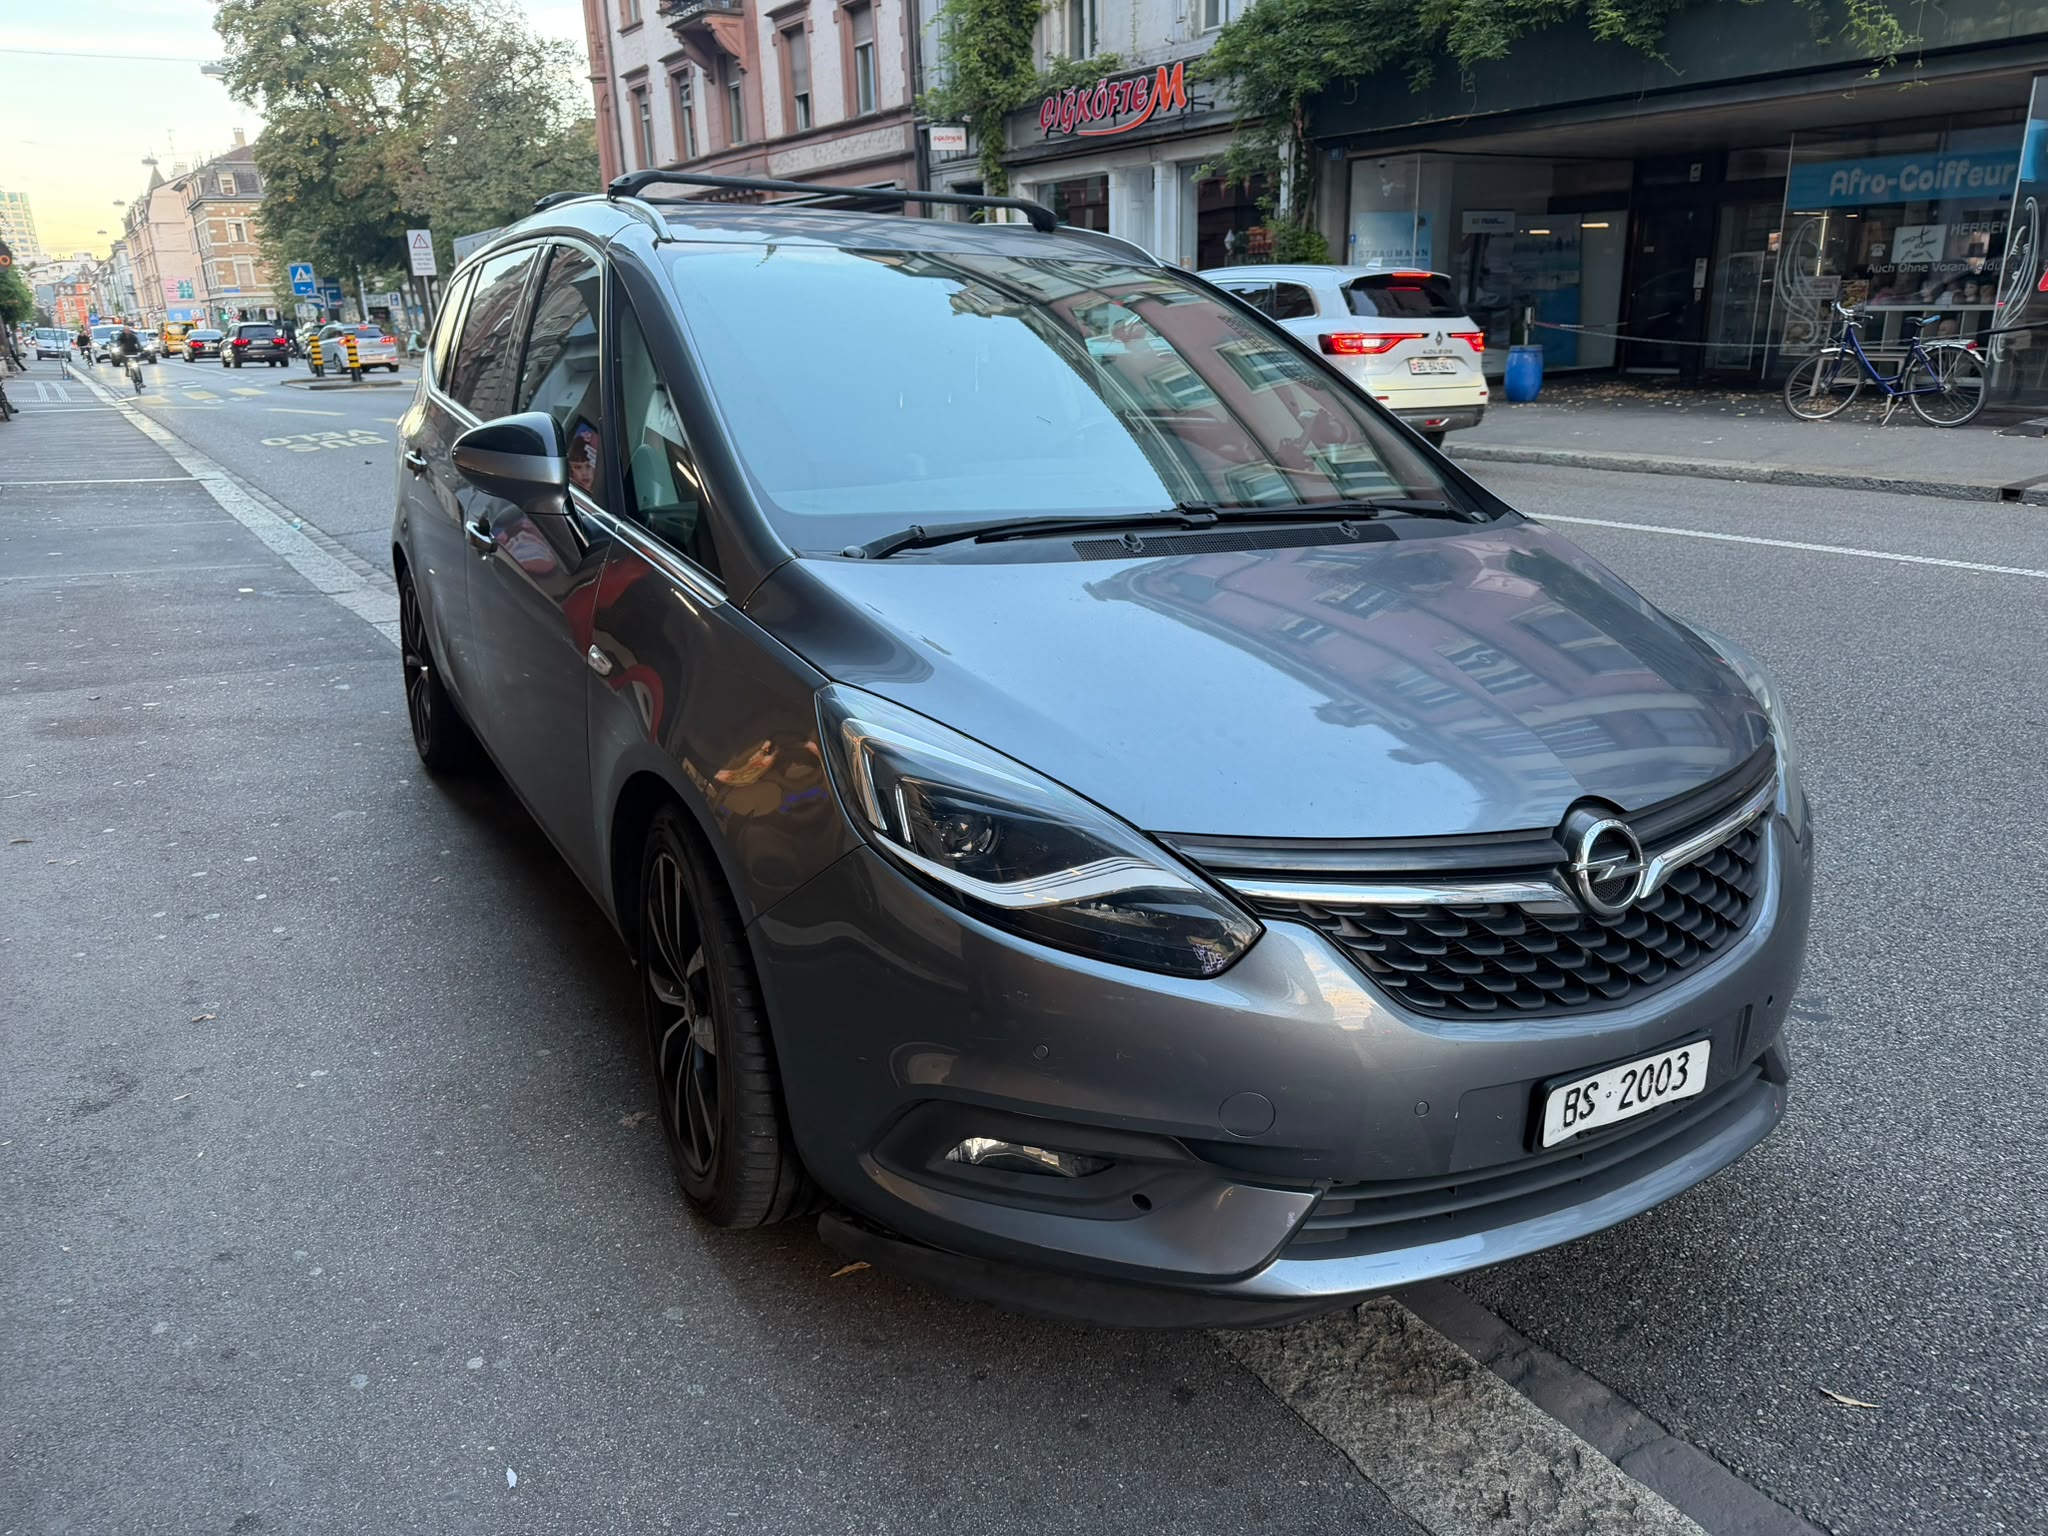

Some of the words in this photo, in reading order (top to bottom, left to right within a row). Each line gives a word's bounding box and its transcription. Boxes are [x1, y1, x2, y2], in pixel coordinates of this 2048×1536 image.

[1829, 159, 2017, 197] Afro-Coiffeur
[1866, 263, 1895, 274] Auch
[1897, 261, 1929, 274] Ohne
[1562, 1080, 1600, 1129] BS
[1617, 1050, 1691, 1112] 2003
